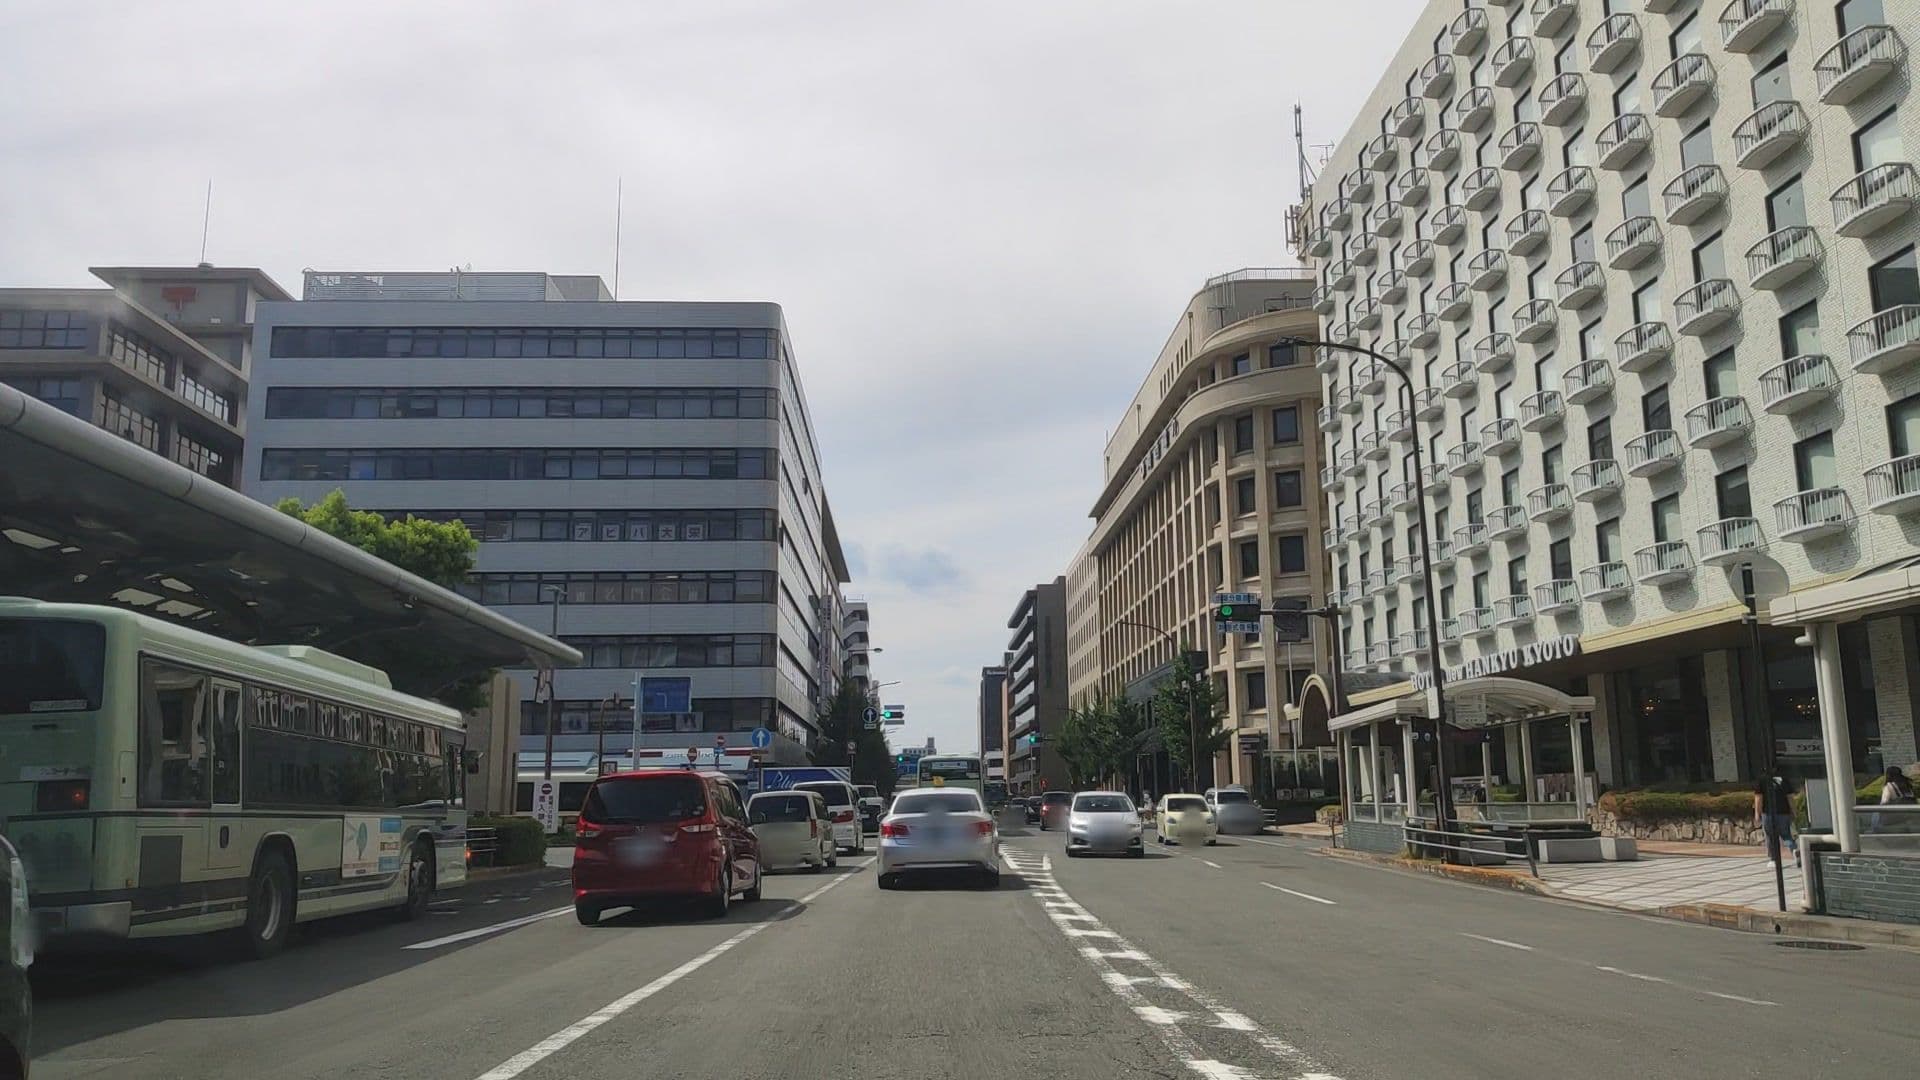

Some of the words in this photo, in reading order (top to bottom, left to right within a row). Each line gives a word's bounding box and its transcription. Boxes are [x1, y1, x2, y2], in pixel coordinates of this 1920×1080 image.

[1465, 650, 1518, 679] HANKYU
[1523, 635, 1576, 666] KYOTO
[767, 770, 794, 789] Blu
